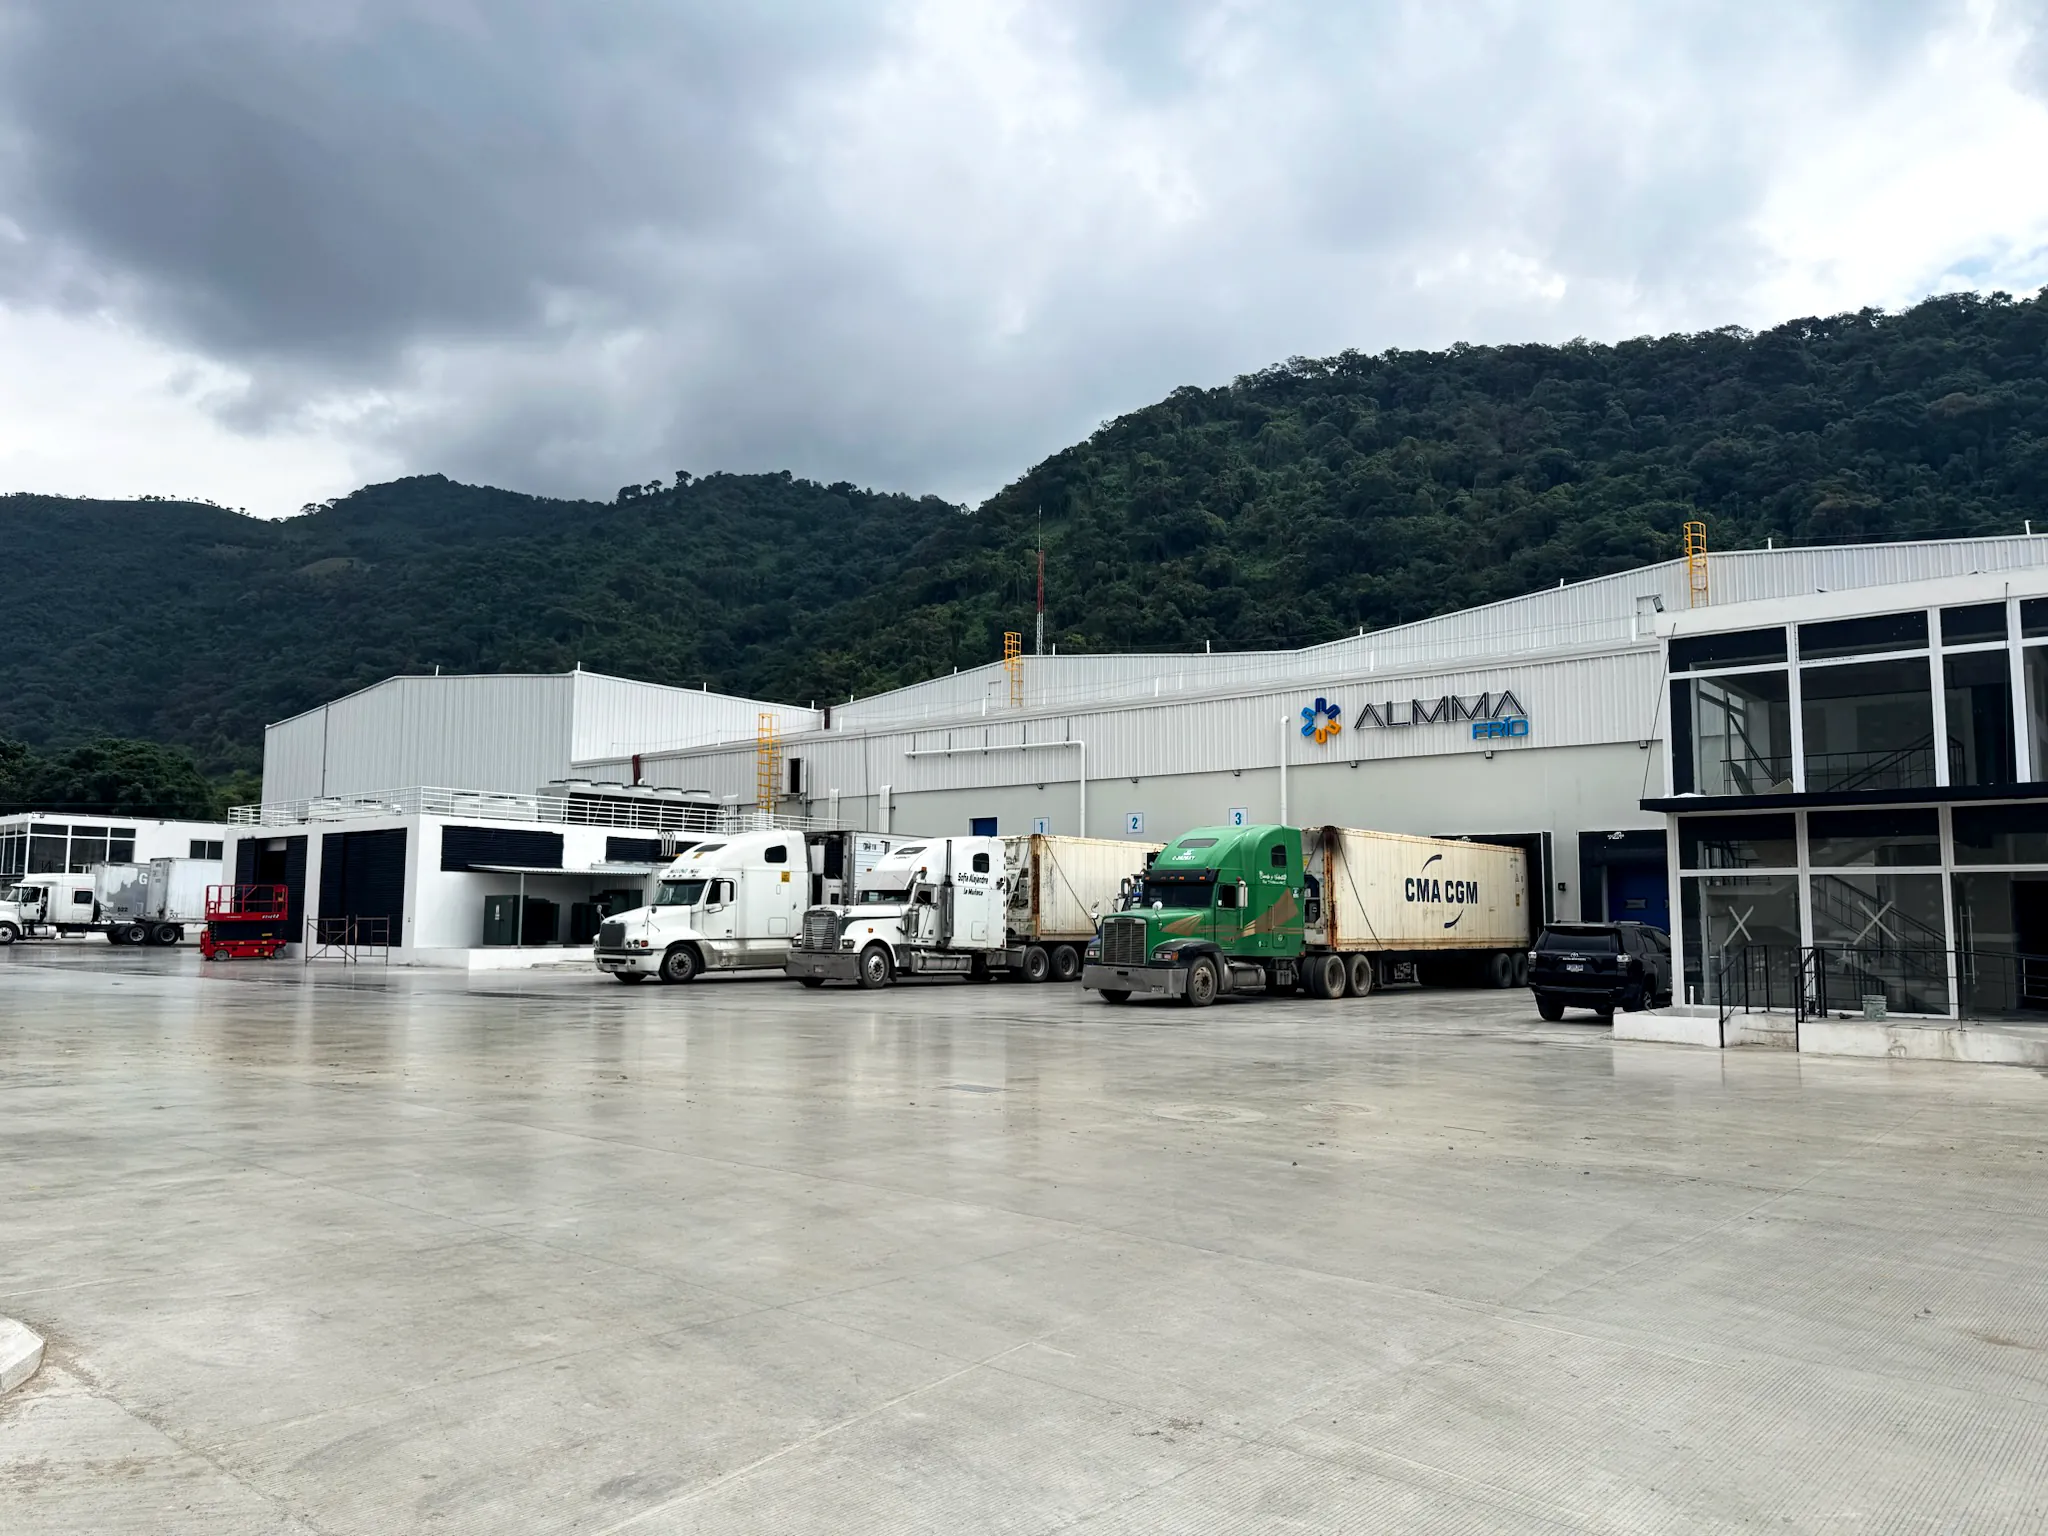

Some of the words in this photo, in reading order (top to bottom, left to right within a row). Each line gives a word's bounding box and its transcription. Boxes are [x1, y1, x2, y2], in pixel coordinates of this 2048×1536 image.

[1353, 689, 1528, 730] ALMMA
[1472, 716, 1529, 740] FRÍO
[1131, 816, 1139, 830] 2
[1234, 812, 1242, 826] 3
[1039, 821, 1044, 834] 1
[138, 872, 149, 885] G
[1405, 877, 1441, 903] CMA
[1445, 880, 1478, 904] CGM
